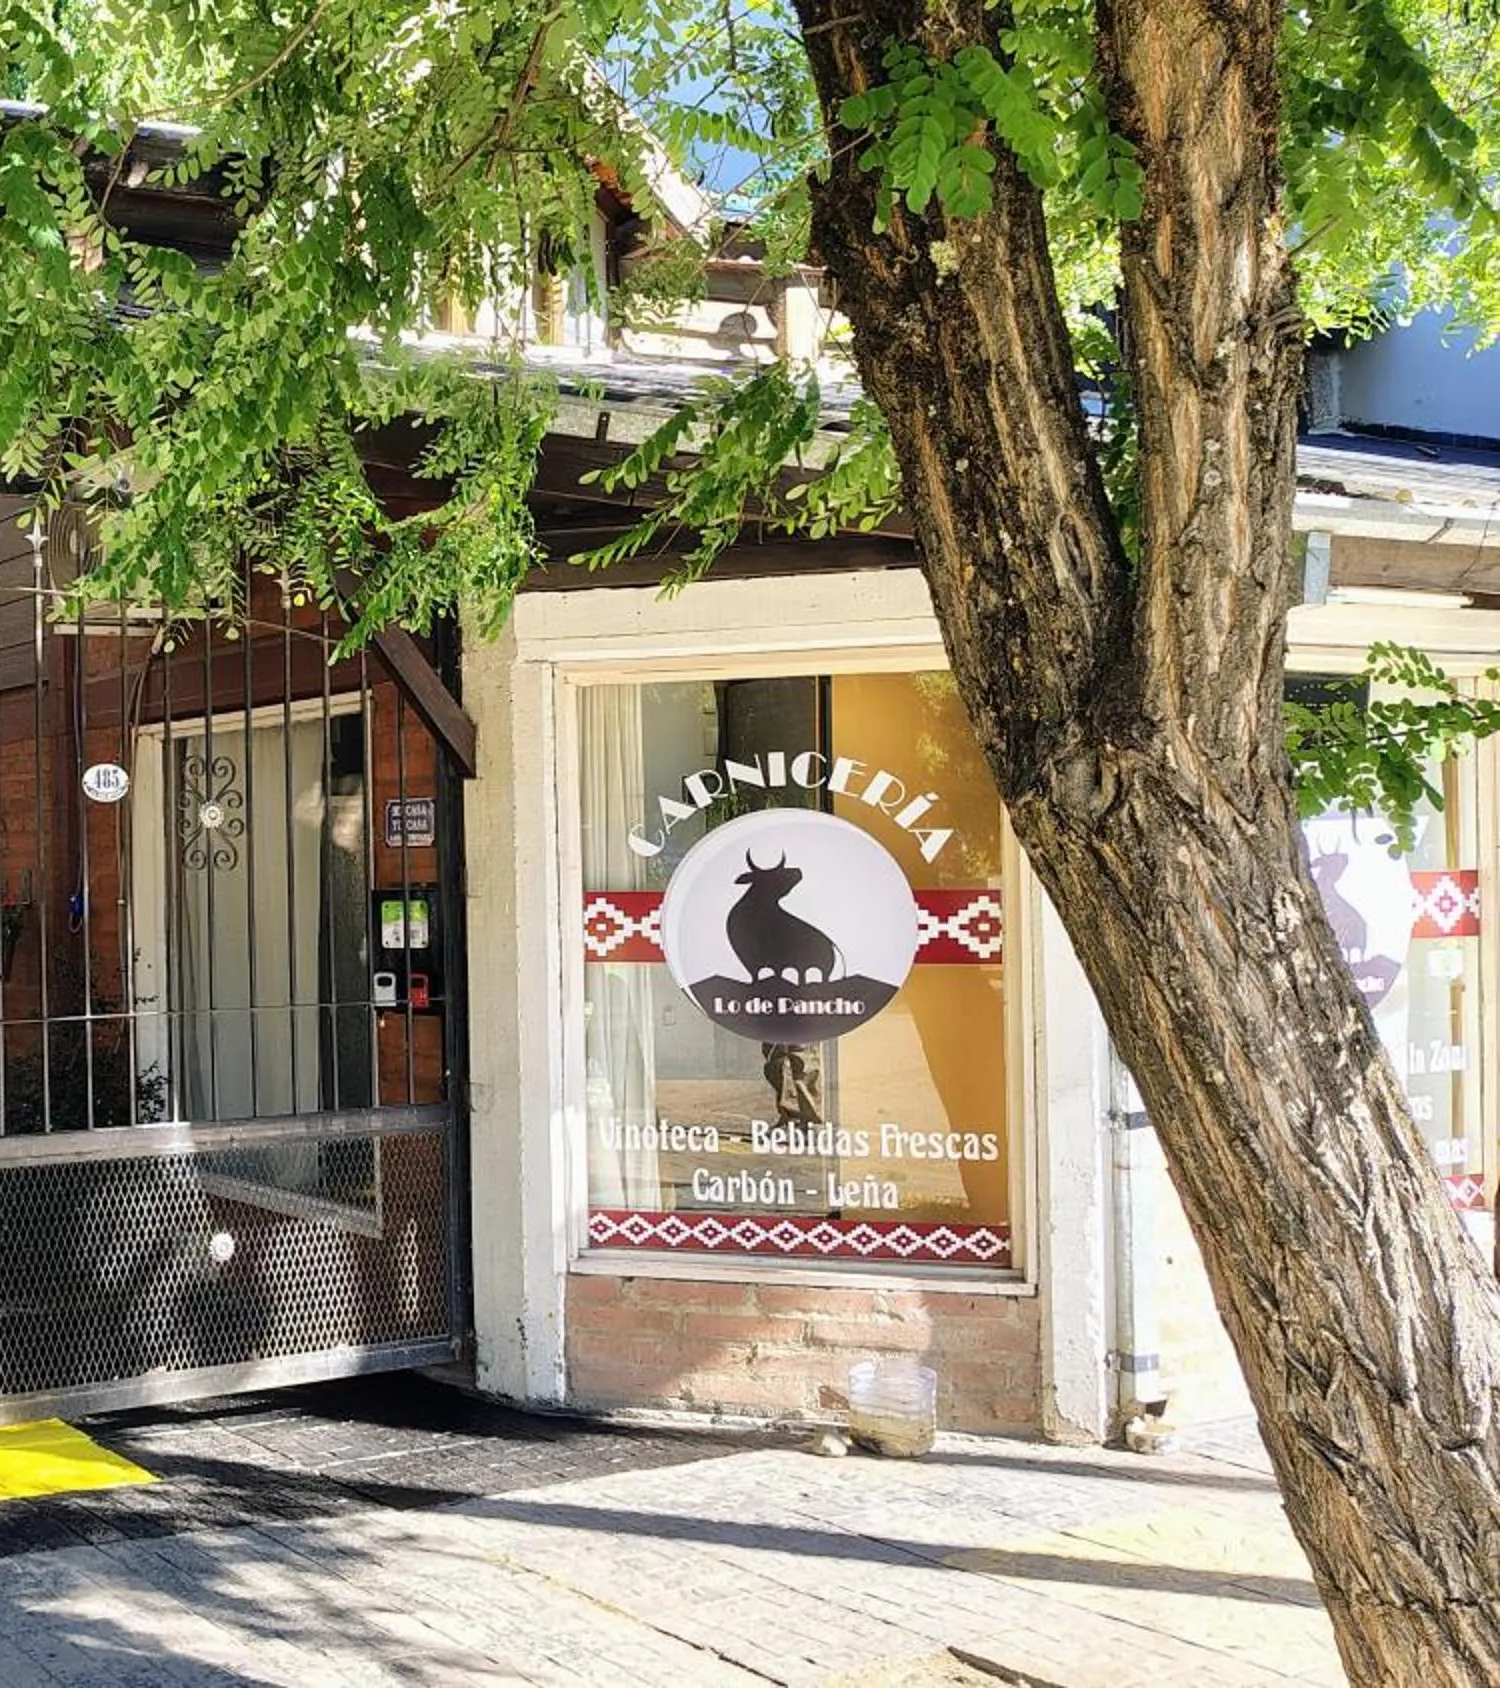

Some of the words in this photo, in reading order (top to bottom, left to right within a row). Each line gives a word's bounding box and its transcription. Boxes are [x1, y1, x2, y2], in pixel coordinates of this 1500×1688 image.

[94, 767, 120, 789] 485
[627, 751, 956, 865] CARNICERÍA
[713, 997, 741, 1015] Lo
[745, 997, 773, 1015] de
[776, 997, 866, 1015] Pancho
[600, 1117, 719, 1153] Vinoteca
[750, 1119, 871, 1158] Bebidas
[879, 1123, 999, 1161] Frescas
[691, 1167, 796, 1205] Carbón
[826, 1173, 900, 1209] Leña
